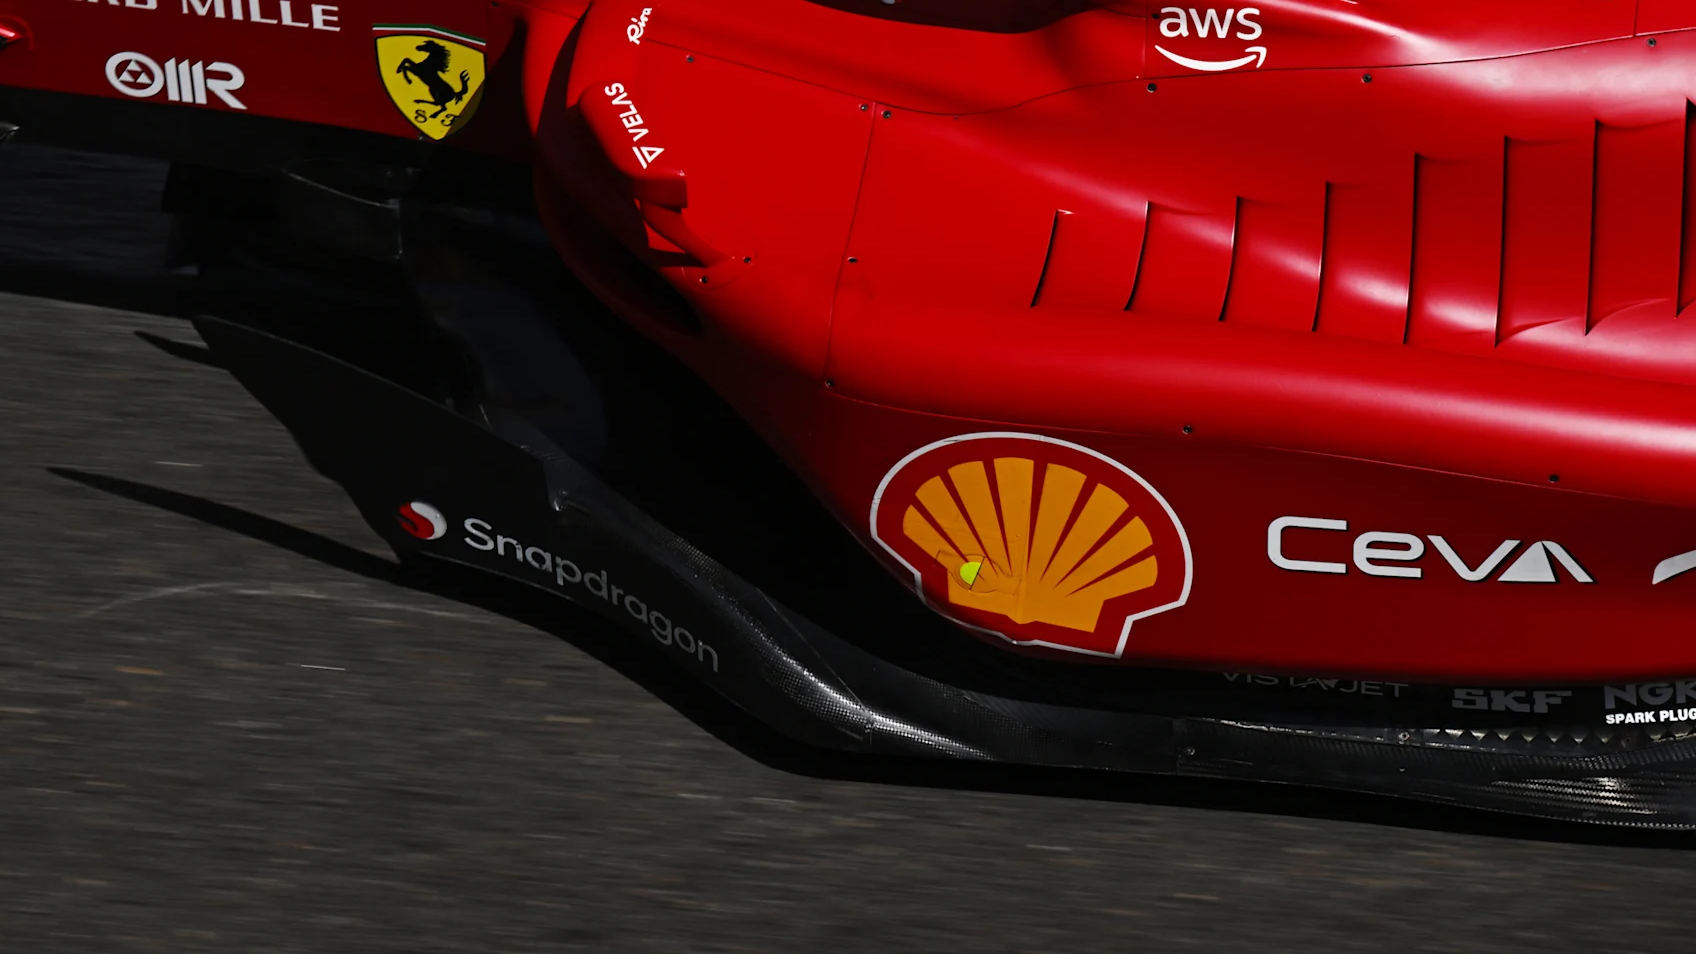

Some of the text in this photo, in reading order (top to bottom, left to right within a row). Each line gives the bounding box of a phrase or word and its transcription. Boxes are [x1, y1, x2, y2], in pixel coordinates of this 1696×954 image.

[627, 7, 652, 44] Riva
[1159, 6, 1263, 40] aws
[605, 83, 649, 141] VELAS
[463, 518, 720, 673] Snapdragon
[1451, 689, 1573, 713] SKF
[1605, 711, 1656, 725] SPARK
